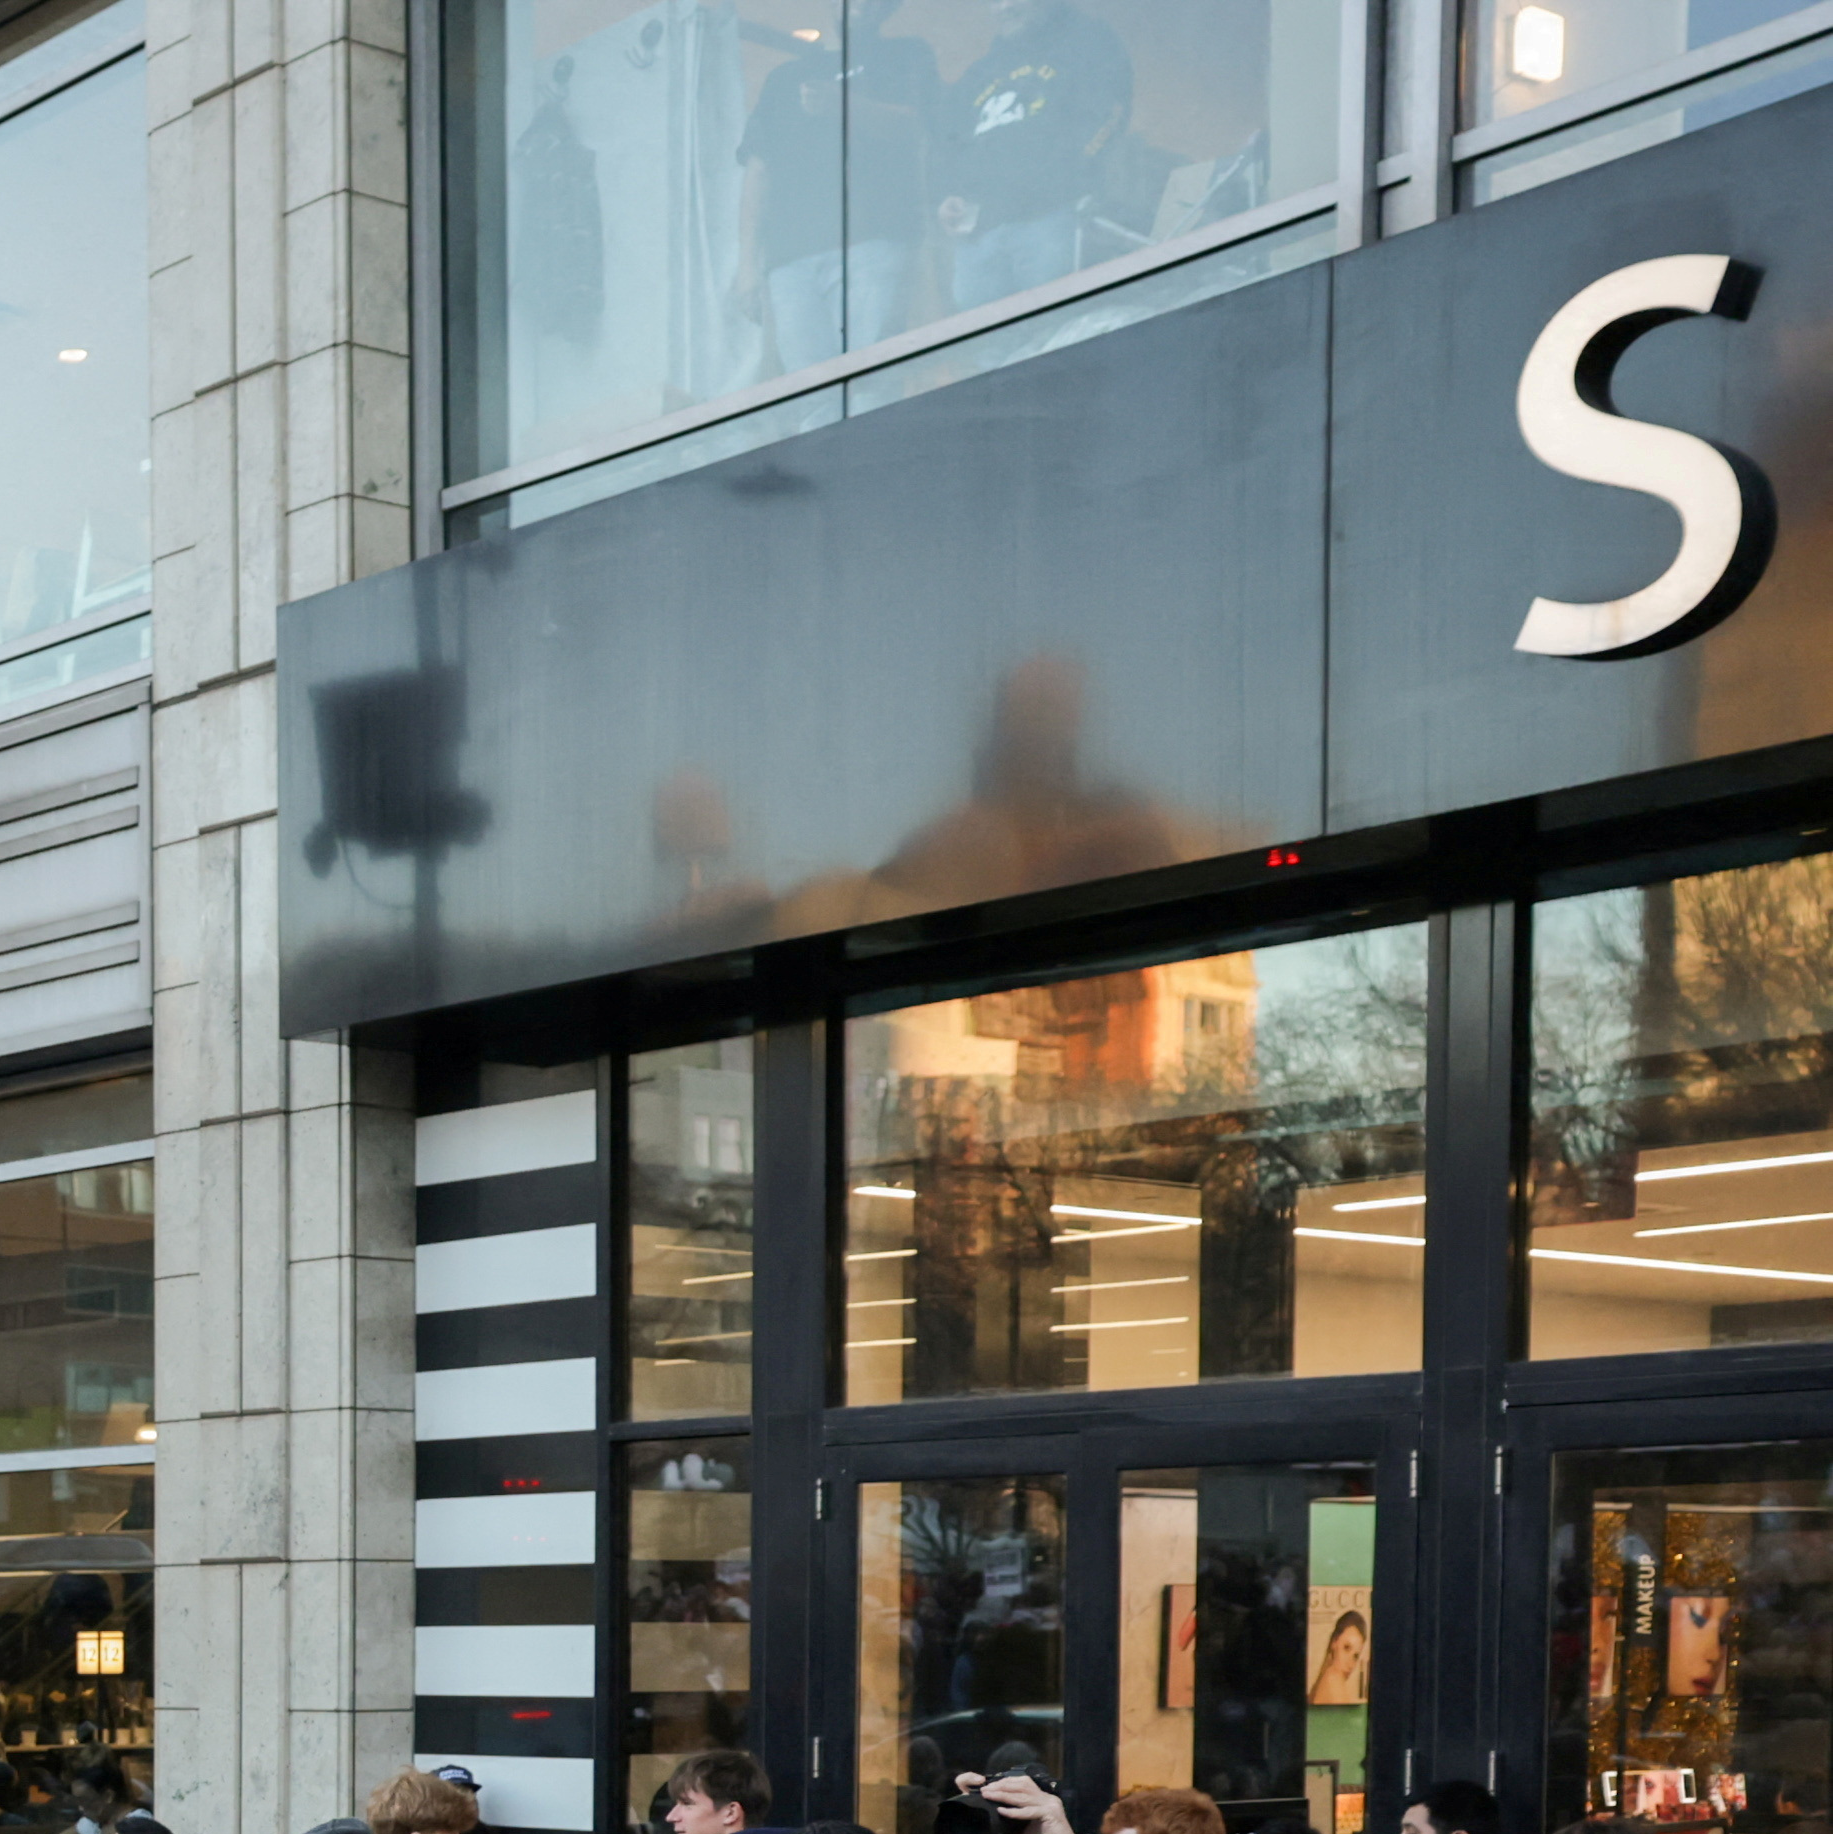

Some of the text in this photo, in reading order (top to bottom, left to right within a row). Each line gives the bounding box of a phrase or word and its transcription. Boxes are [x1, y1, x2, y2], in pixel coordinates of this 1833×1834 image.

[1514, 254, 1774, 660] S
[1636, 1553, 1658, 1635] MAKEUP
[81, 1645, 119, 1662] 12 12
